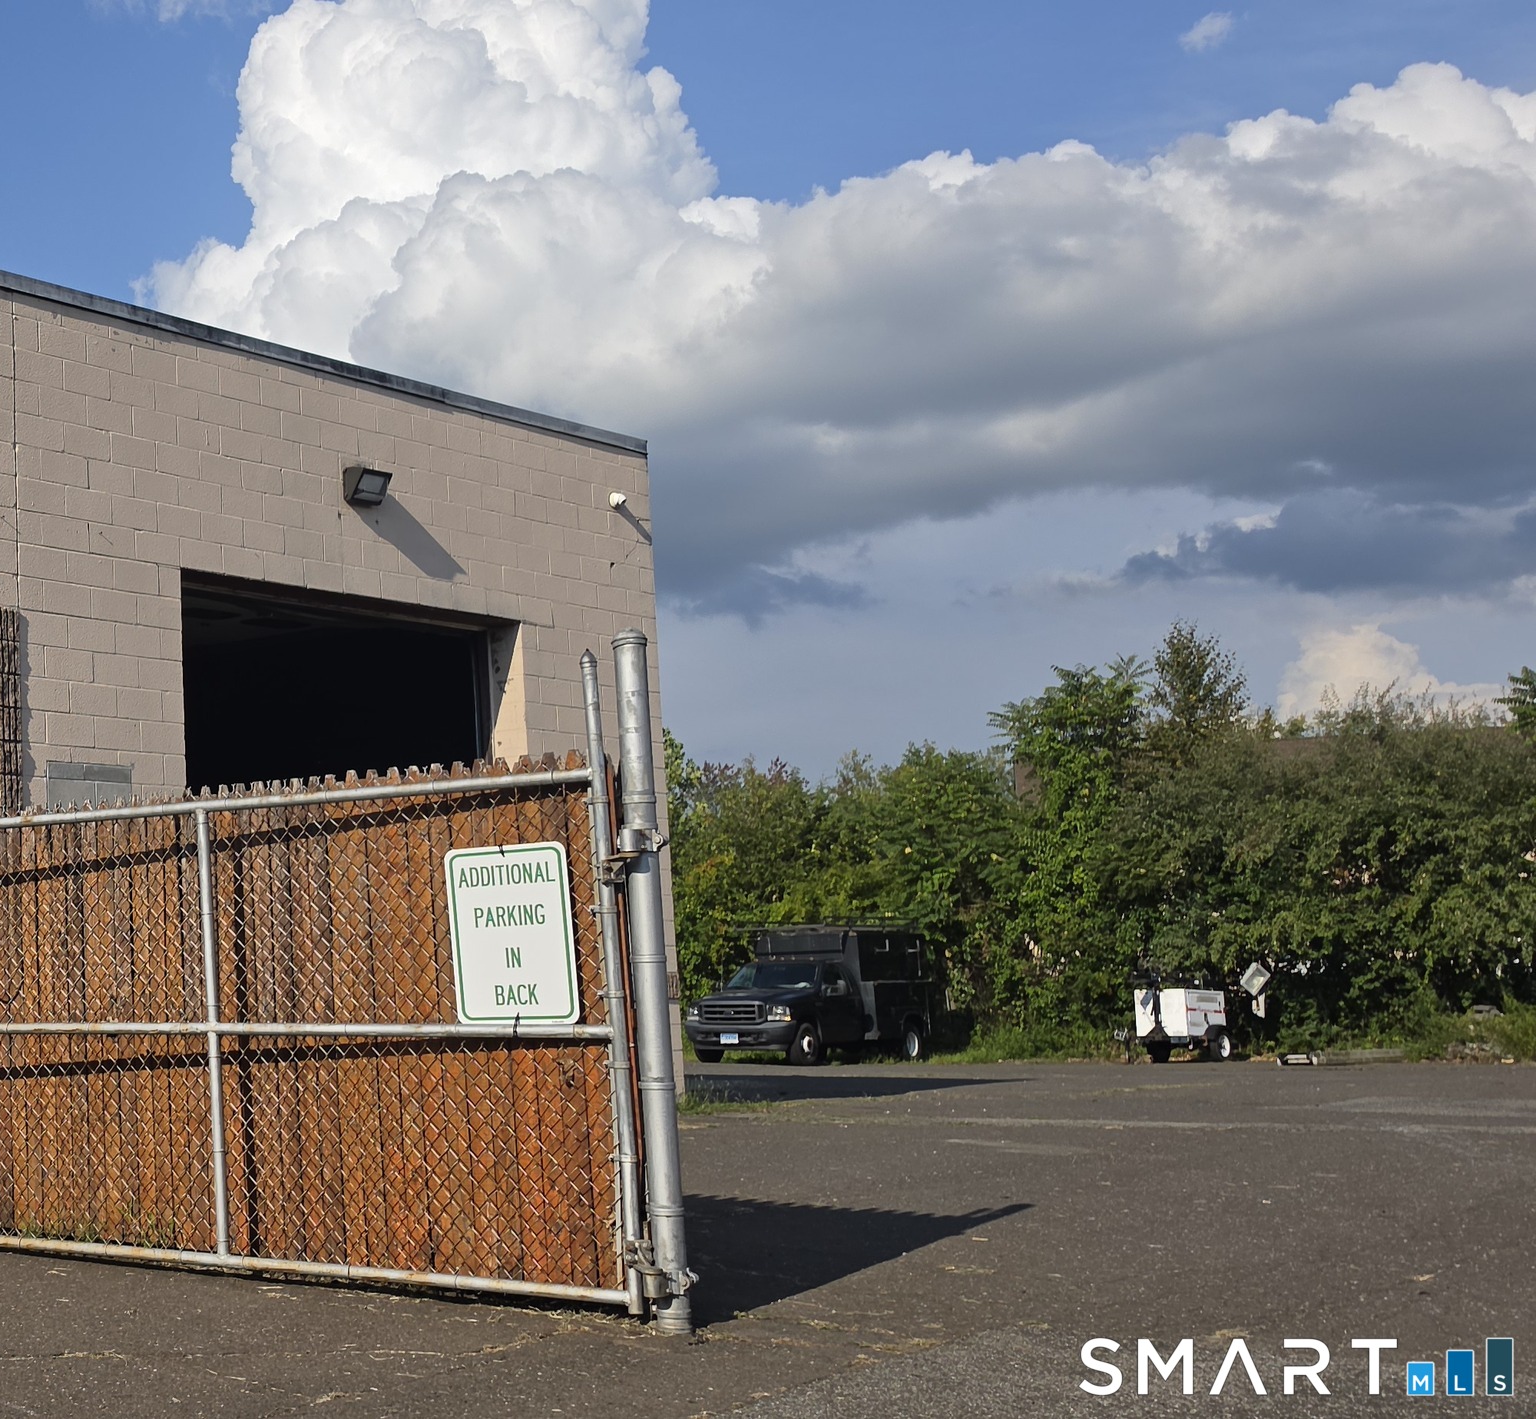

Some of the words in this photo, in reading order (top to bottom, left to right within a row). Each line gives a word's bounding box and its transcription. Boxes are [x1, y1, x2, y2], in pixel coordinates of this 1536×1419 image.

[458, 861, 556, 888] ADDITIONAL
[474, 903, 546, 928] PARKING
[505, 947, 522, 968] IN
[494, 984, 539, 1006] BACK
